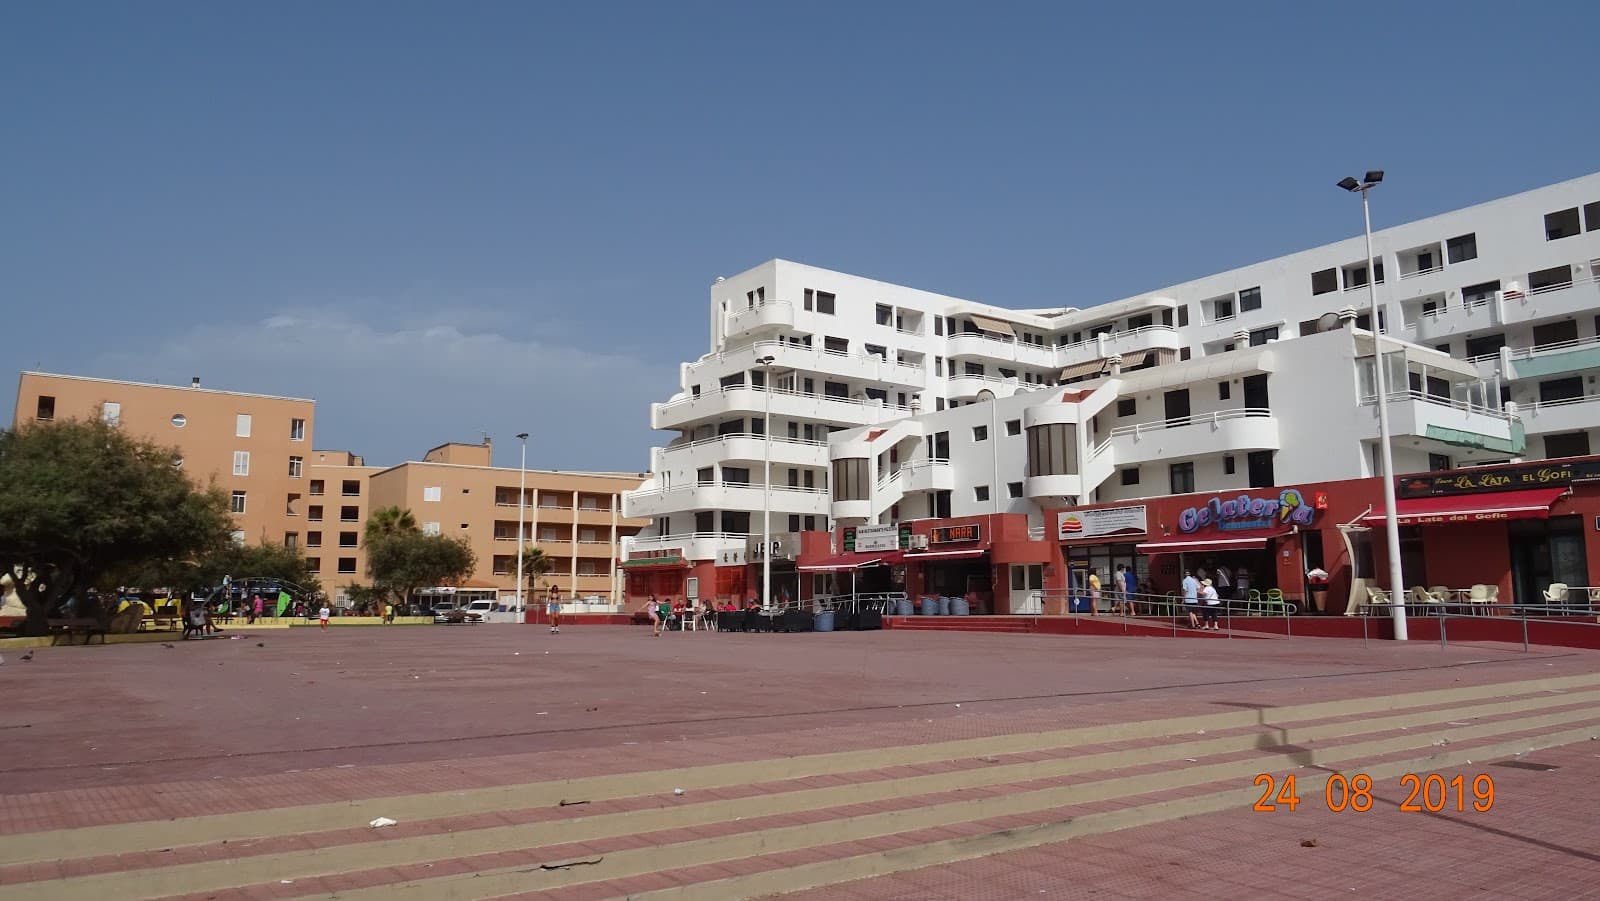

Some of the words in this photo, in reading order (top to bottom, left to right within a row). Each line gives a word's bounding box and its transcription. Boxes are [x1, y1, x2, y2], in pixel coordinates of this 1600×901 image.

[1454, 474, 1477, 489] LA
[1478, 473, 1511, 487] LATA
[1522, 473, 1535, 482] EL
[949, 527, 973, 538] NARA
